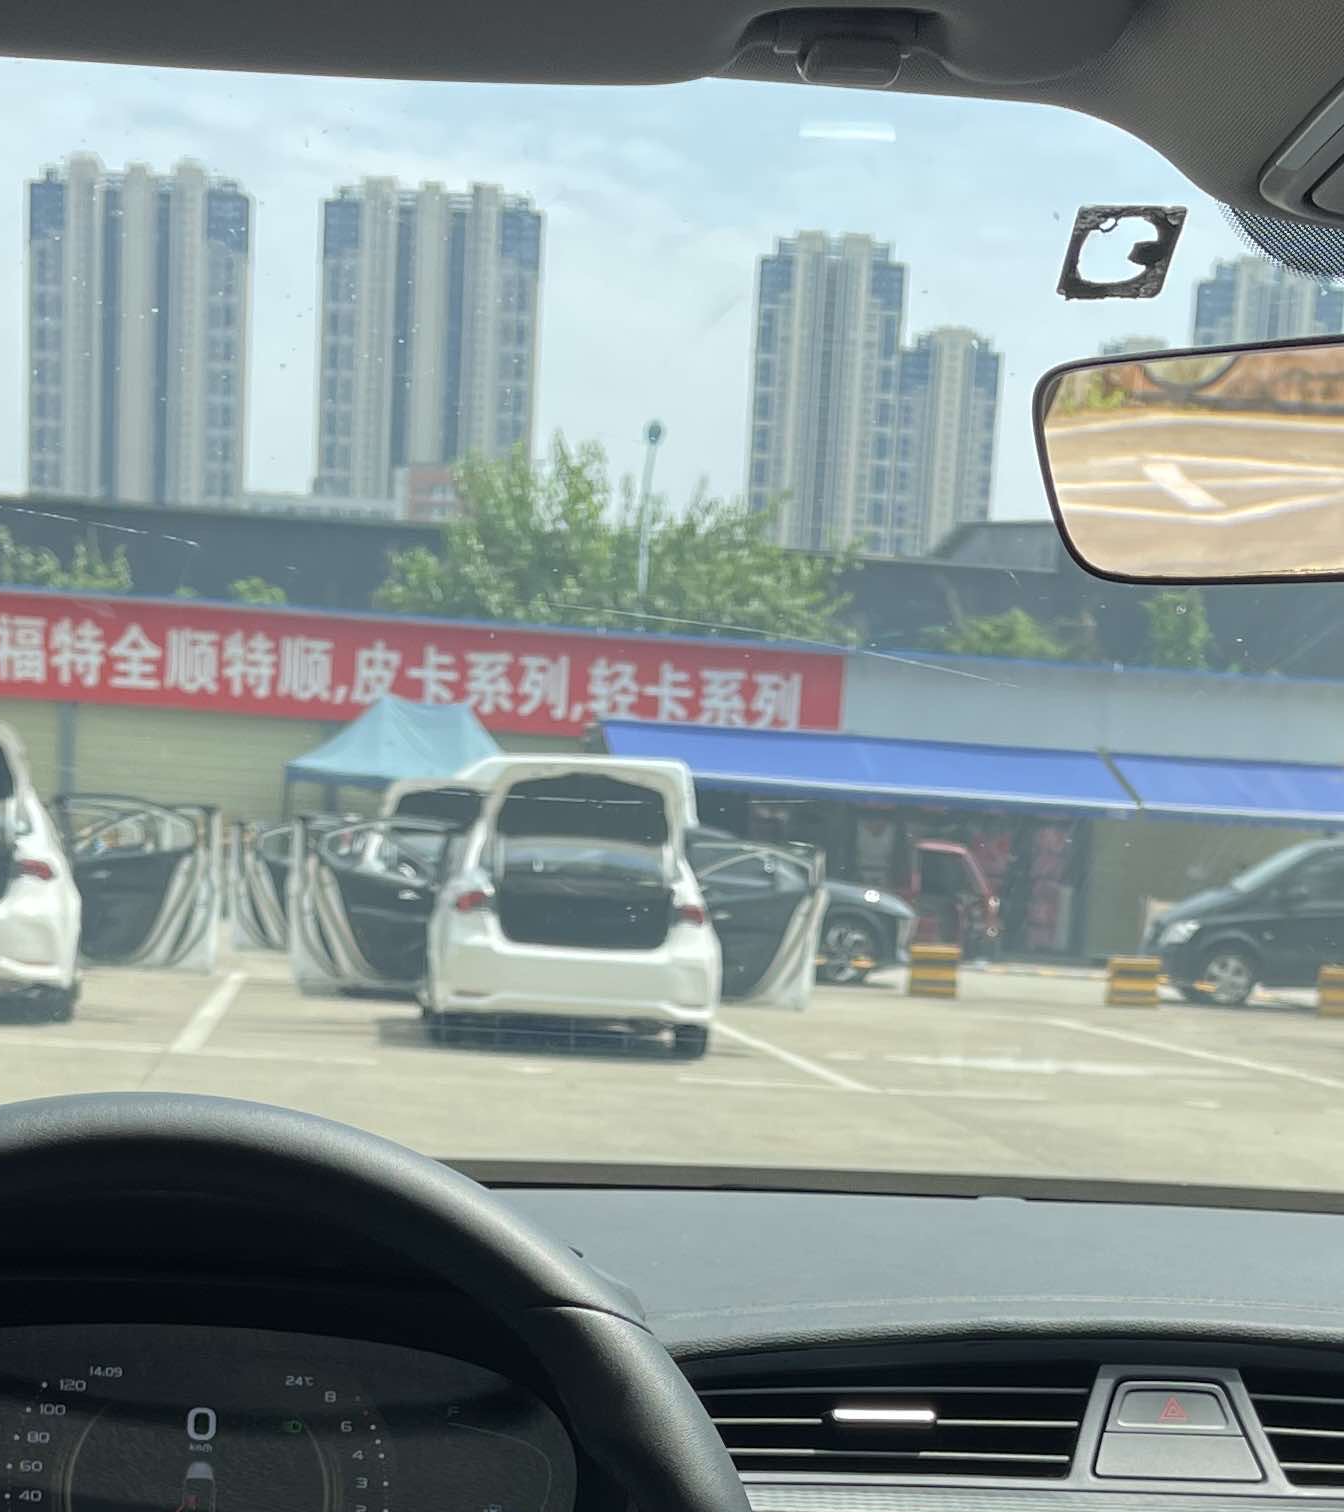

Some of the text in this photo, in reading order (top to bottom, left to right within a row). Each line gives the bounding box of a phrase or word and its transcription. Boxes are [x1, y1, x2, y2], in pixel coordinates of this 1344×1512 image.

[59, 1379, 86, 1391] 120
[39, 1404, 66, 1415] 100
[186, 1407, 217, 1441] 0
[340, 1421, 352, 1432] 6
[27, 1431, 50, 1443] 80
[352, 1450, 364, 1461] 4
[19, 1460, 43, 1472] 60
[355, 1478, 368, 1489] 3
[19, 1490, 42, 1502] 40
